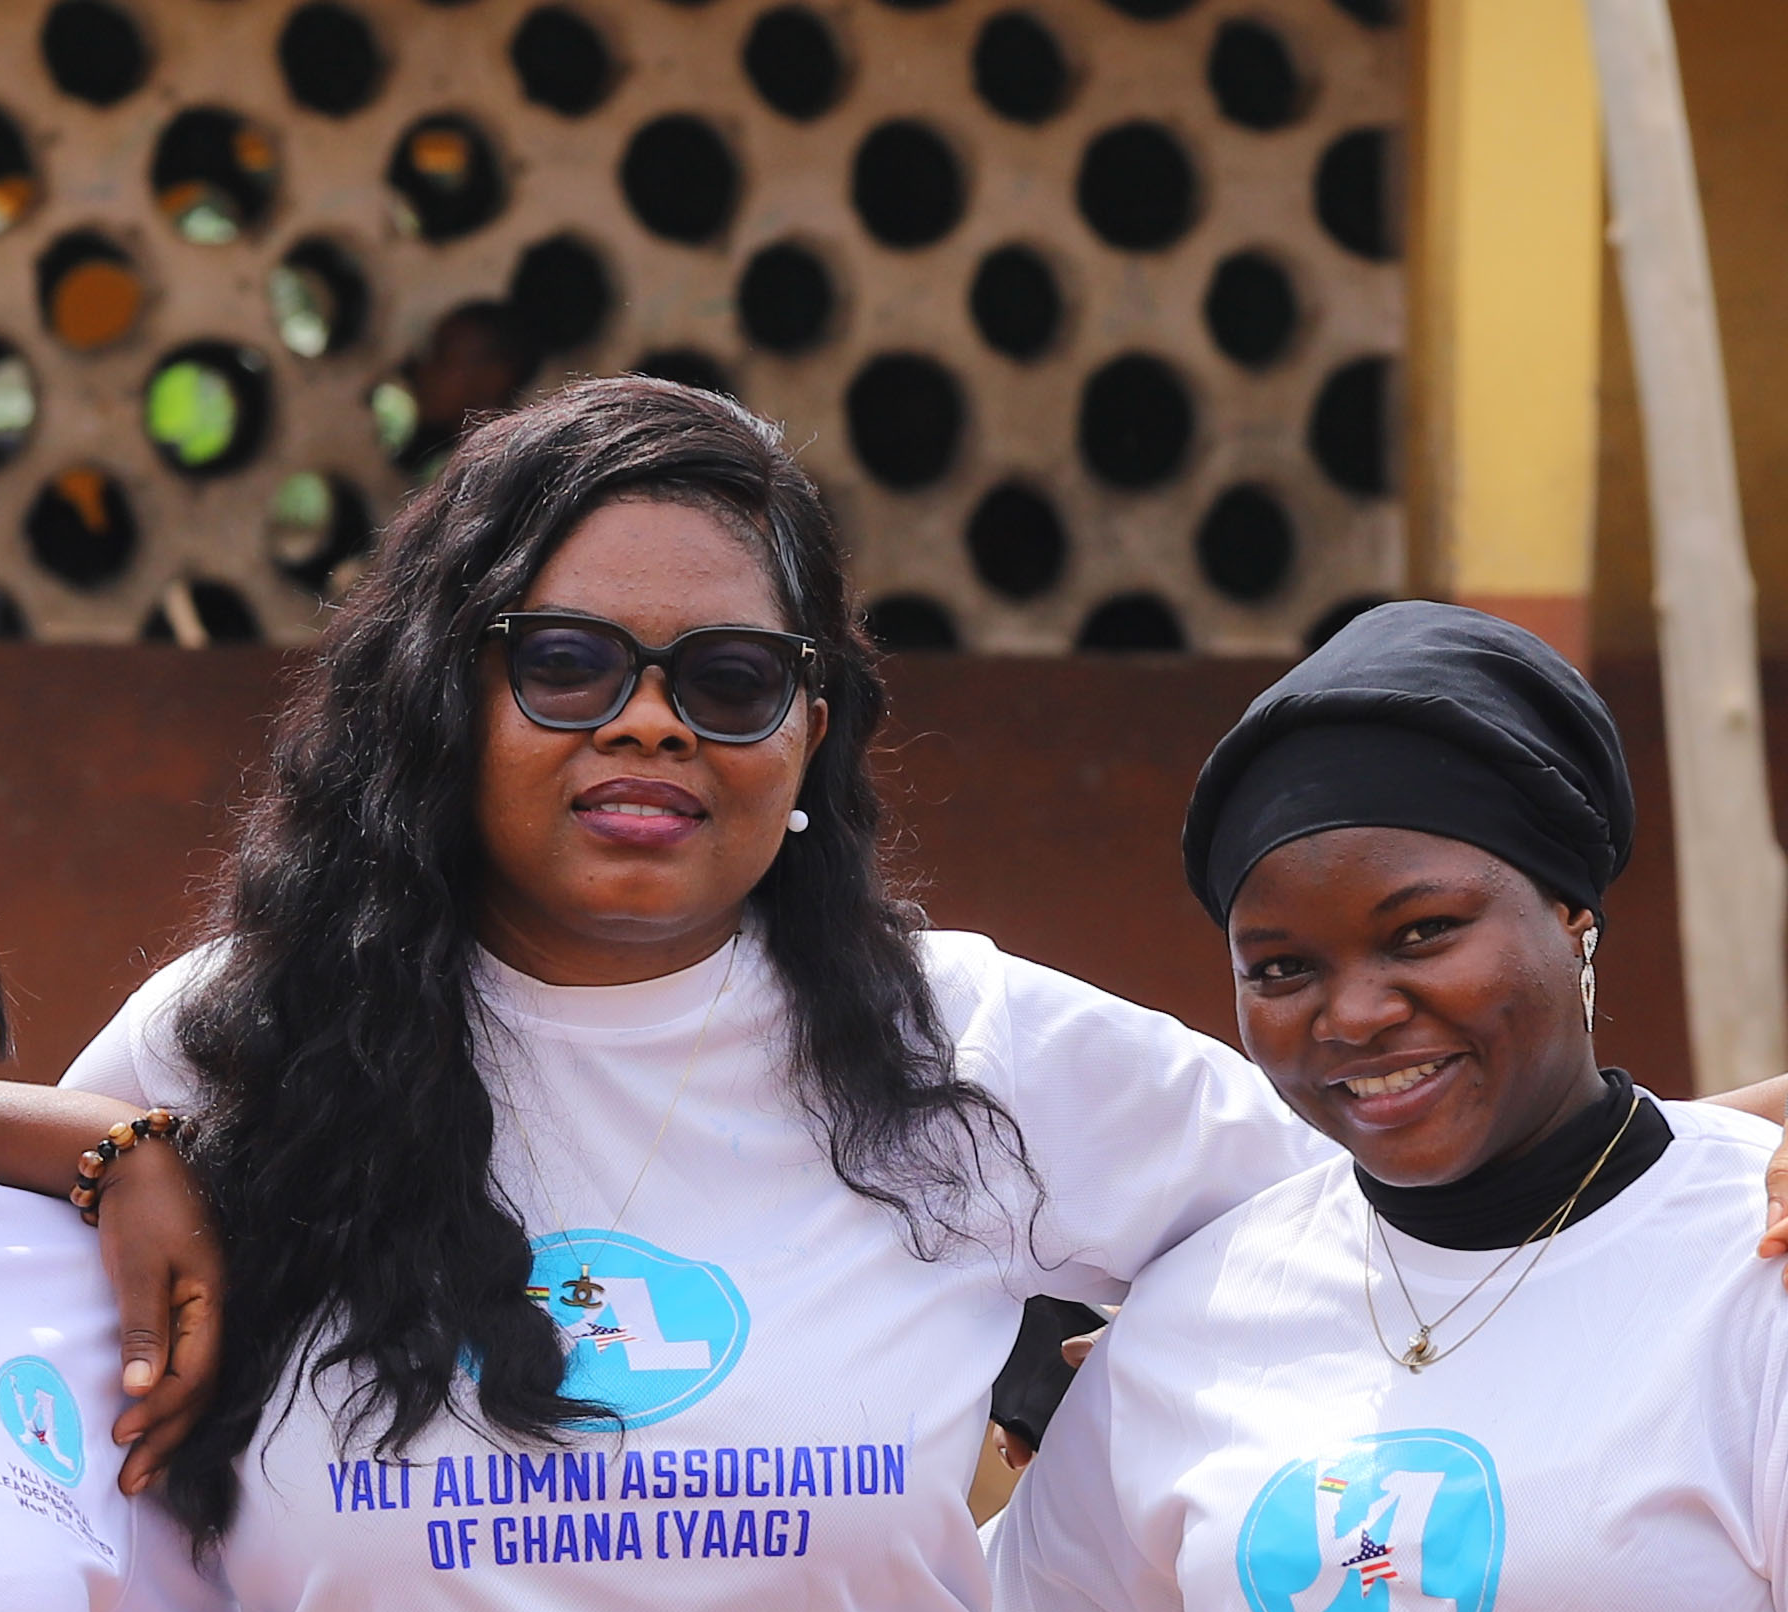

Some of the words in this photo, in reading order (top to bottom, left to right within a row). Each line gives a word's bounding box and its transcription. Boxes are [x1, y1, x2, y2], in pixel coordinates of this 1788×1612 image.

[327, 1457, 412, 1513] YALI
[432, 1452, 607, 1508] ALUMNI
[619, 1443, 905, 1500] ASSOCIATION
[426, 1518, 479, 1570] OF
[492, 1511, 643, 1566] GHANA
